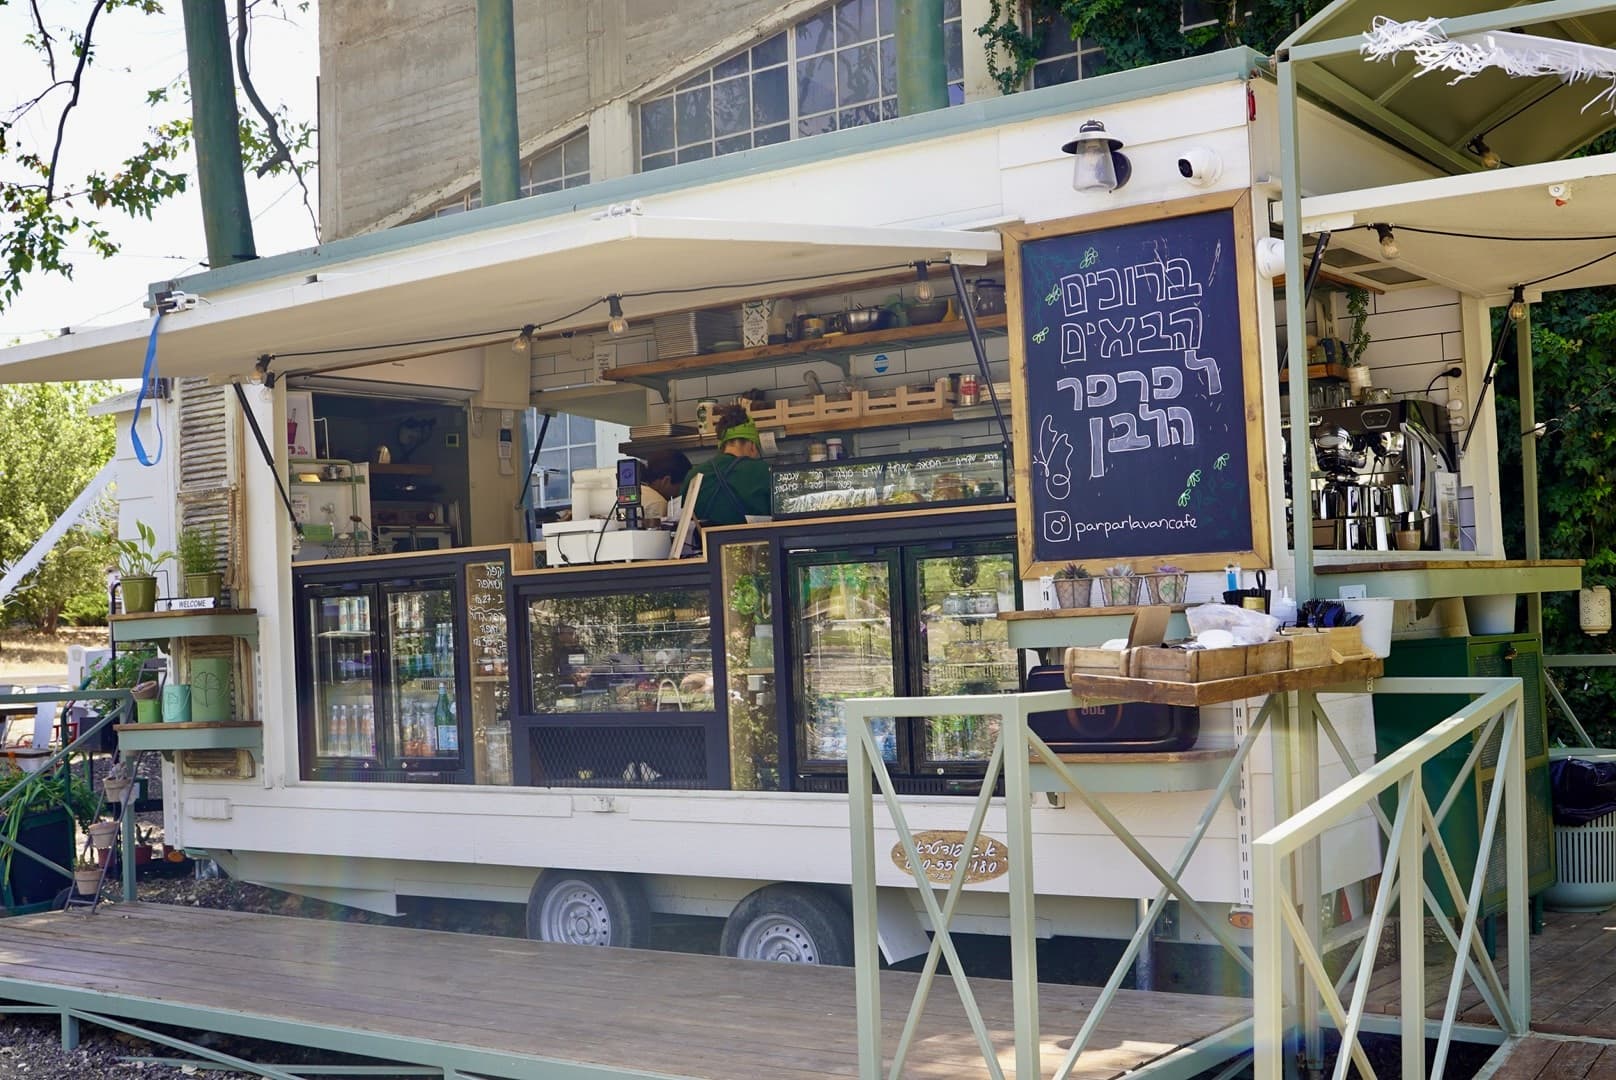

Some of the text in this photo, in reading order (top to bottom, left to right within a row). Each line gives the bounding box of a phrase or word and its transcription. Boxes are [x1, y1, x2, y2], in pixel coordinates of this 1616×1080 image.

[1059, 257, 1203, 318] ברוכים
[1060, 306, 1203, 365] הבאים
[1088, 402, 1195, 480] הלבן
[1075, 513, 1198, 542] parparlavancafe
[178, 599, 208, 609] WELCOME
